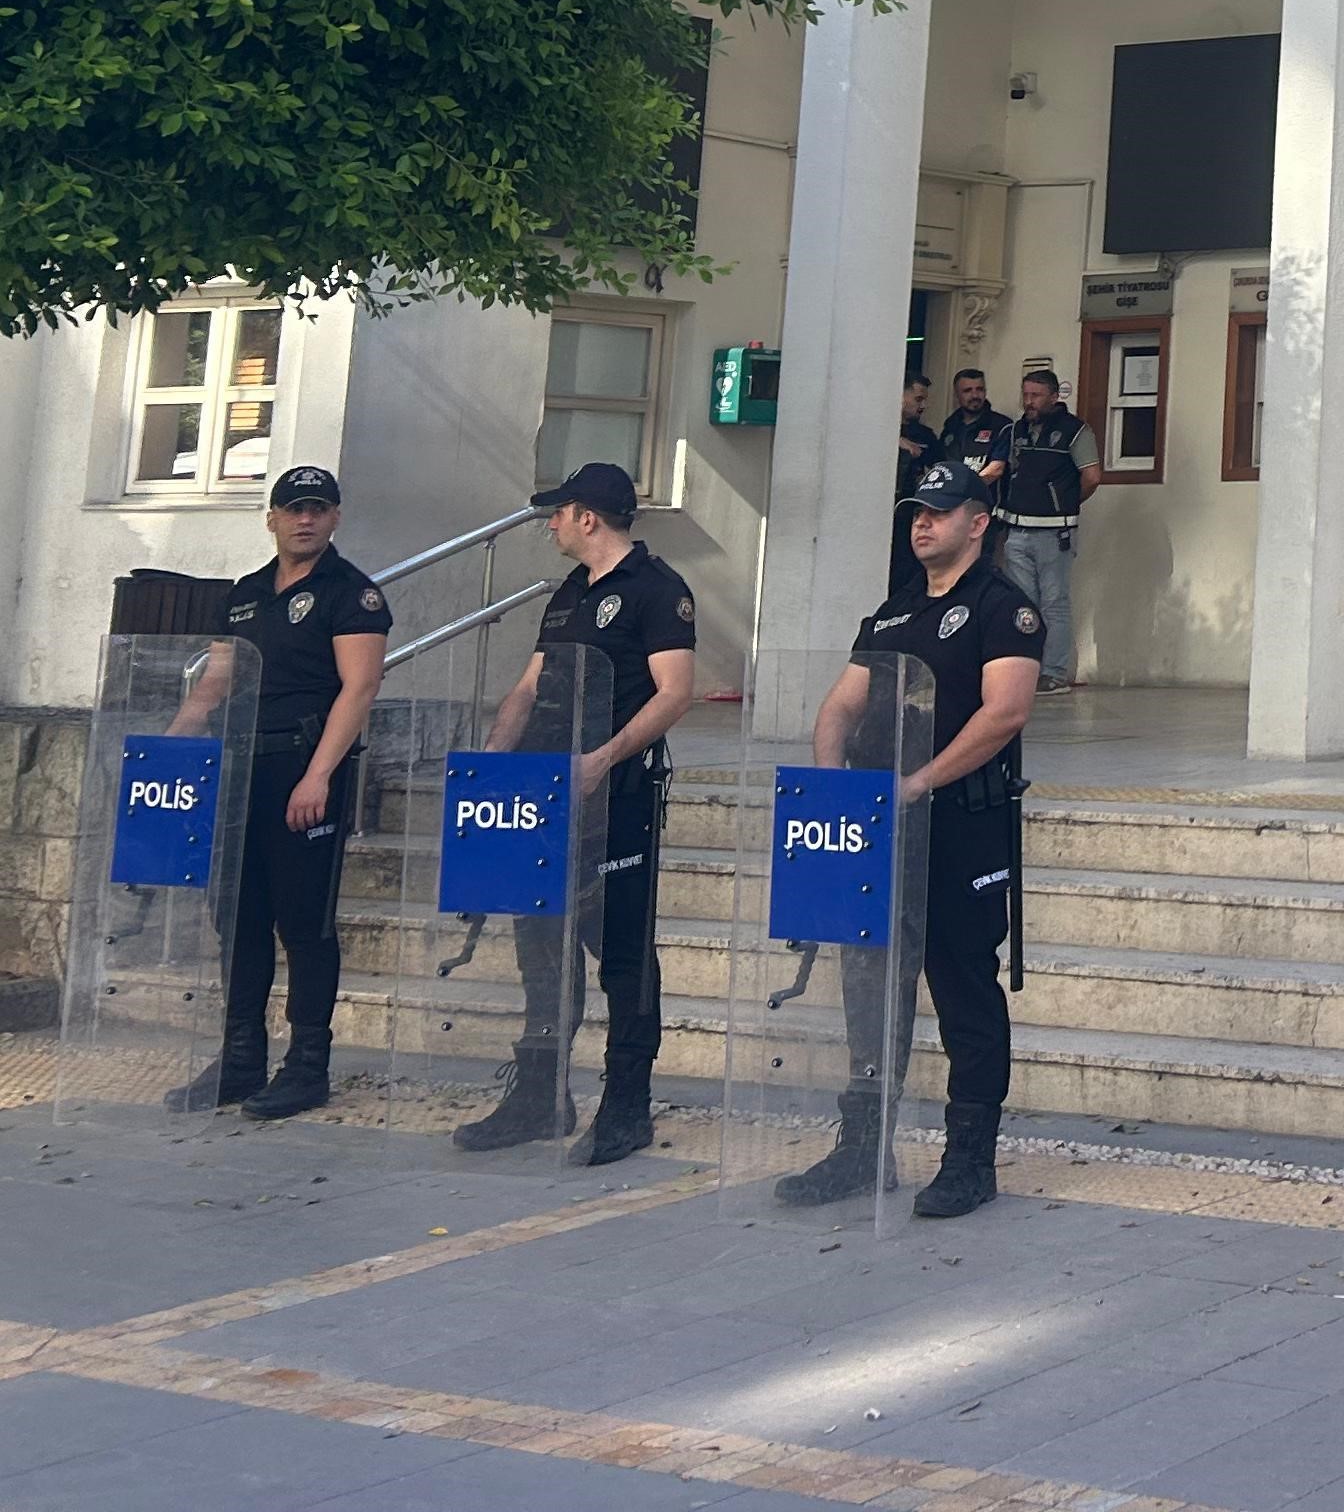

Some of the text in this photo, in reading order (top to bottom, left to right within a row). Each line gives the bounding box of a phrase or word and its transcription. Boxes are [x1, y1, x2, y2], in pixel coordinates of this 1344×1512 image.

[129, 781, 196, 810] POLİS
[456, 795, 538, 830] POLİS
[785, 815, 864, 853] POLİS
